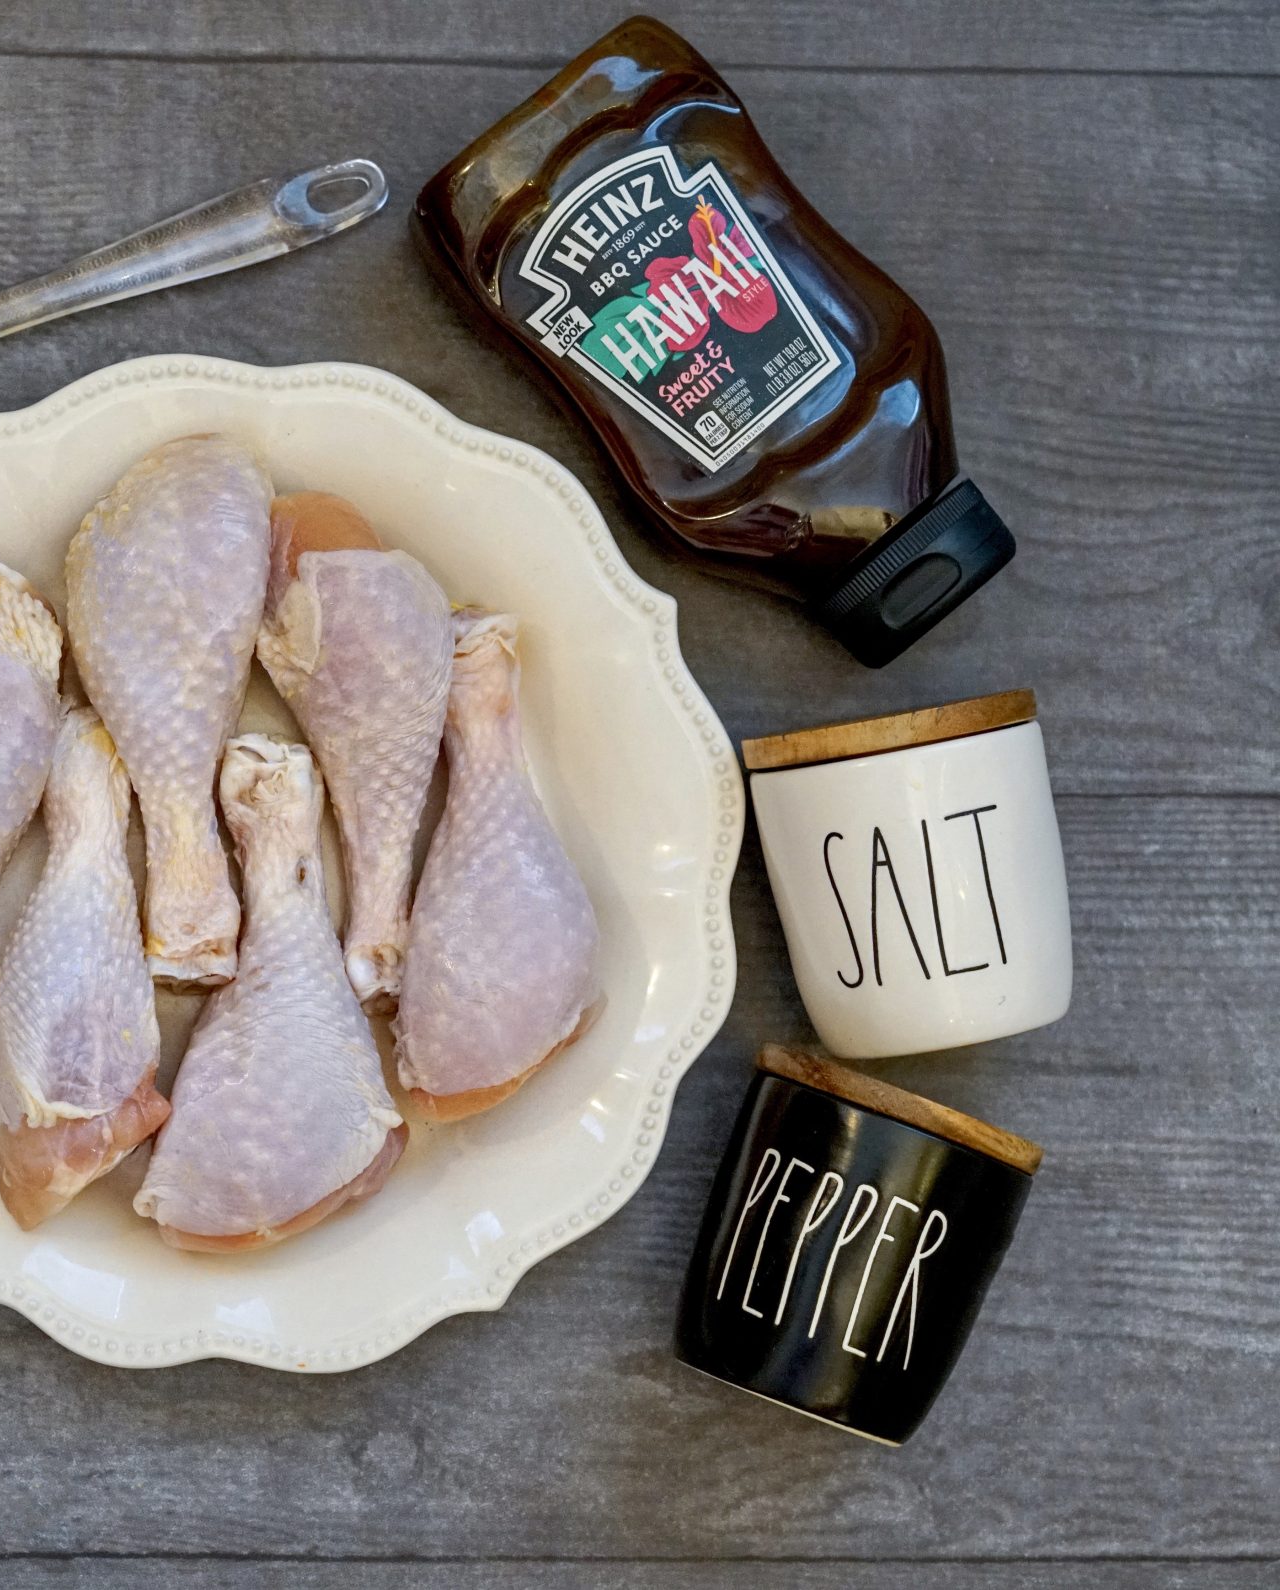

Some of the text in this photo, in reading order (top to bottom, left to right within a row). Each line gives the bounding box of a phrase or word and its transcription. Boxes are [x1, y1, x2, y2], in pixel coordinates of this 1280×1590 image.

[552, 174, 664, 275] HEINZ
[611, 229, 635, 252] 1869
[589, 214, 683, 297] BBQ SAUCE
[742, 278, 769, 303] STYLE
[600, 234, 761, 383] HAWAII
[552, 313, 574, 340] NEW
[558, 321, 585, 350] LOOK
[658, 340, 723, 403] Sweet &
[762, 336, 807, 378] NET WT 19.8 OZ
[771, 376, 785, 391] LB
[778, 368, 794, 385] 3.8
[787, 360, 805, 378] OZ)
[798, 348, 819, 369] 561g
[671, 356, 735, 417] FRUITY
[712, 377, 747, 409] SEE NUTRITION
[718, 386, 751, 416] INFORMATION
[699, 415, 717, 432] 70
[724, 395, 755, 423] FOR SODIUM
[730, 408, 755, 430] CONTENT
[704, 422, 726, 441] CALORIES
[824, 805, 1007, 988] SALT
[717, 1148, 948, 1371] PEPPER
